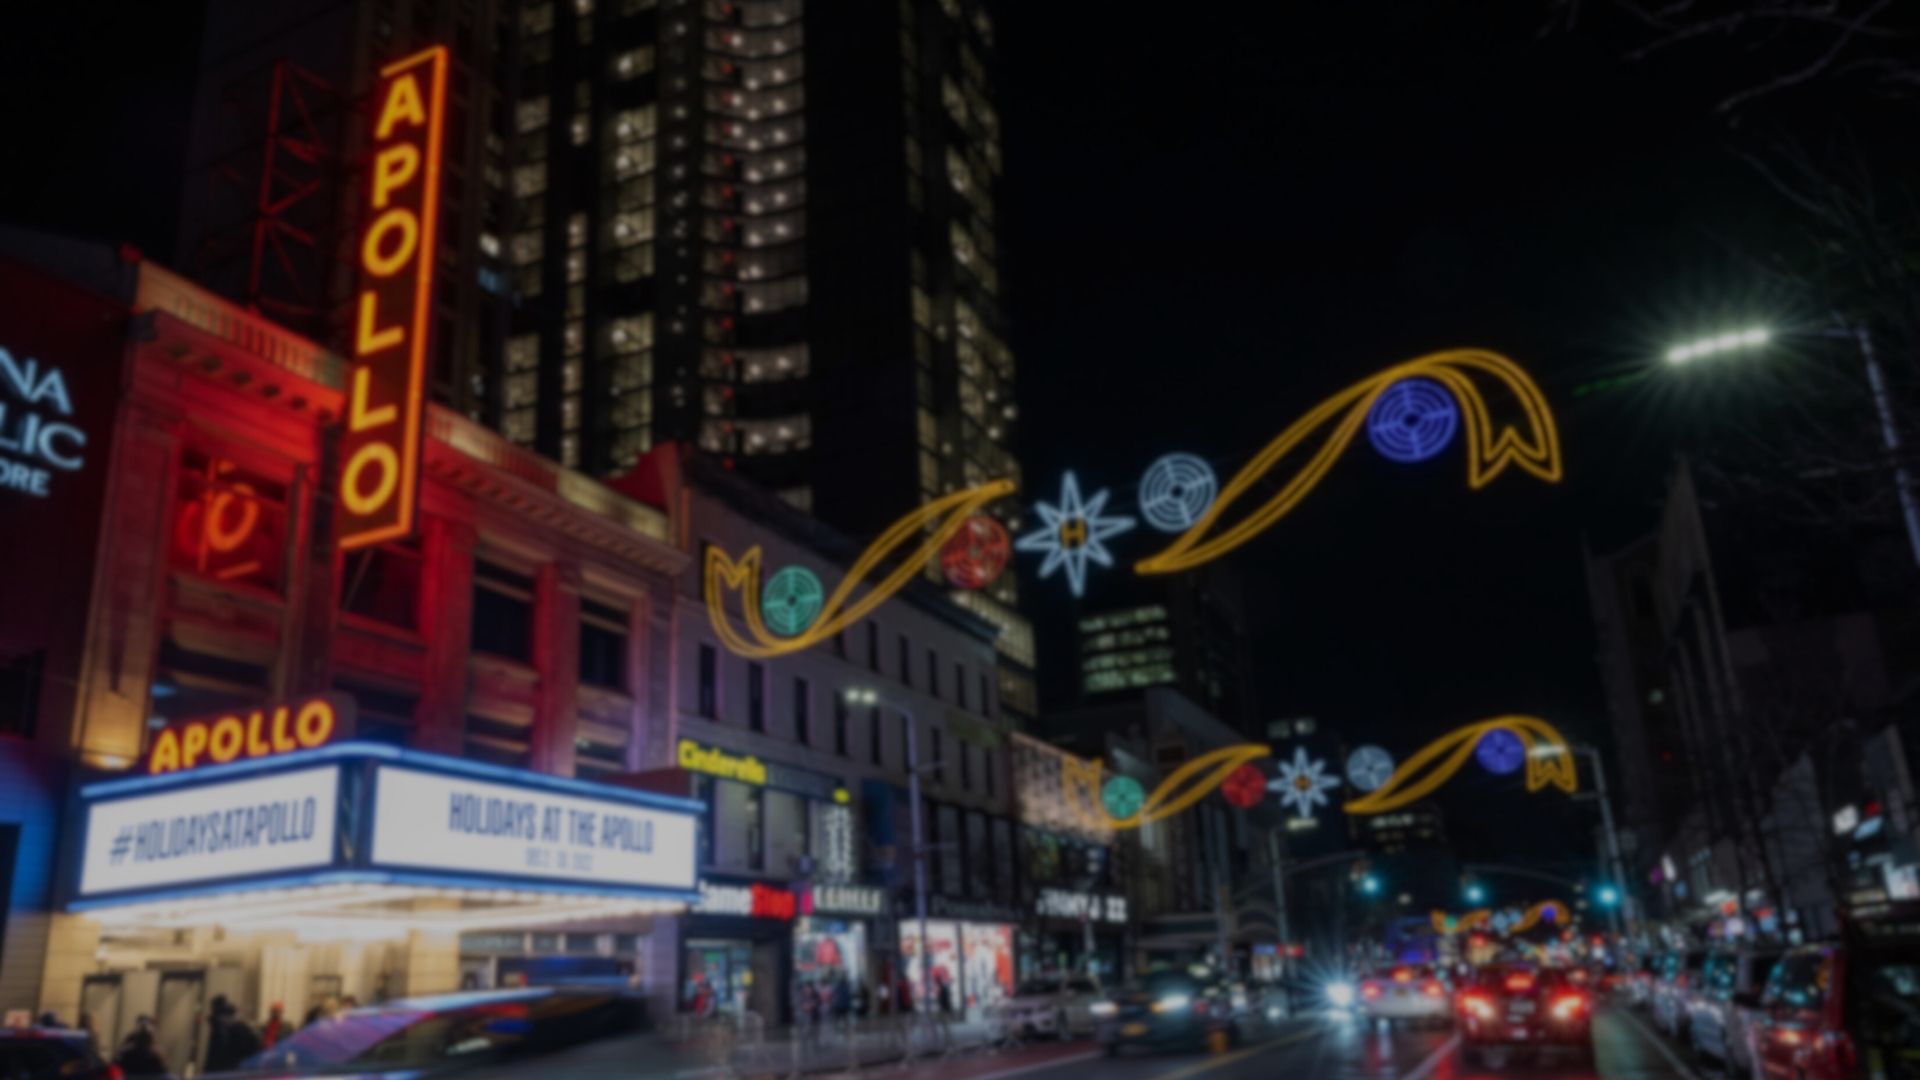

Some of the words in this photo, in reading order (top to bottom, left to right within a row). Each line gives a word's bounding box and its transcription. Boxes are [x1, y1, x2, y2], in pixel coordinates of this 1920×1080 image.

[340, 72, 426, 516] APOLLO
[150, 700, 335, 774] APOLLO
[449, 793, 535, 840] HOLIDAYS
[542, 806, 562, 842] AT
[570, 809, 596, 847] THE
[602, 814, 655, 854] APOLLO
